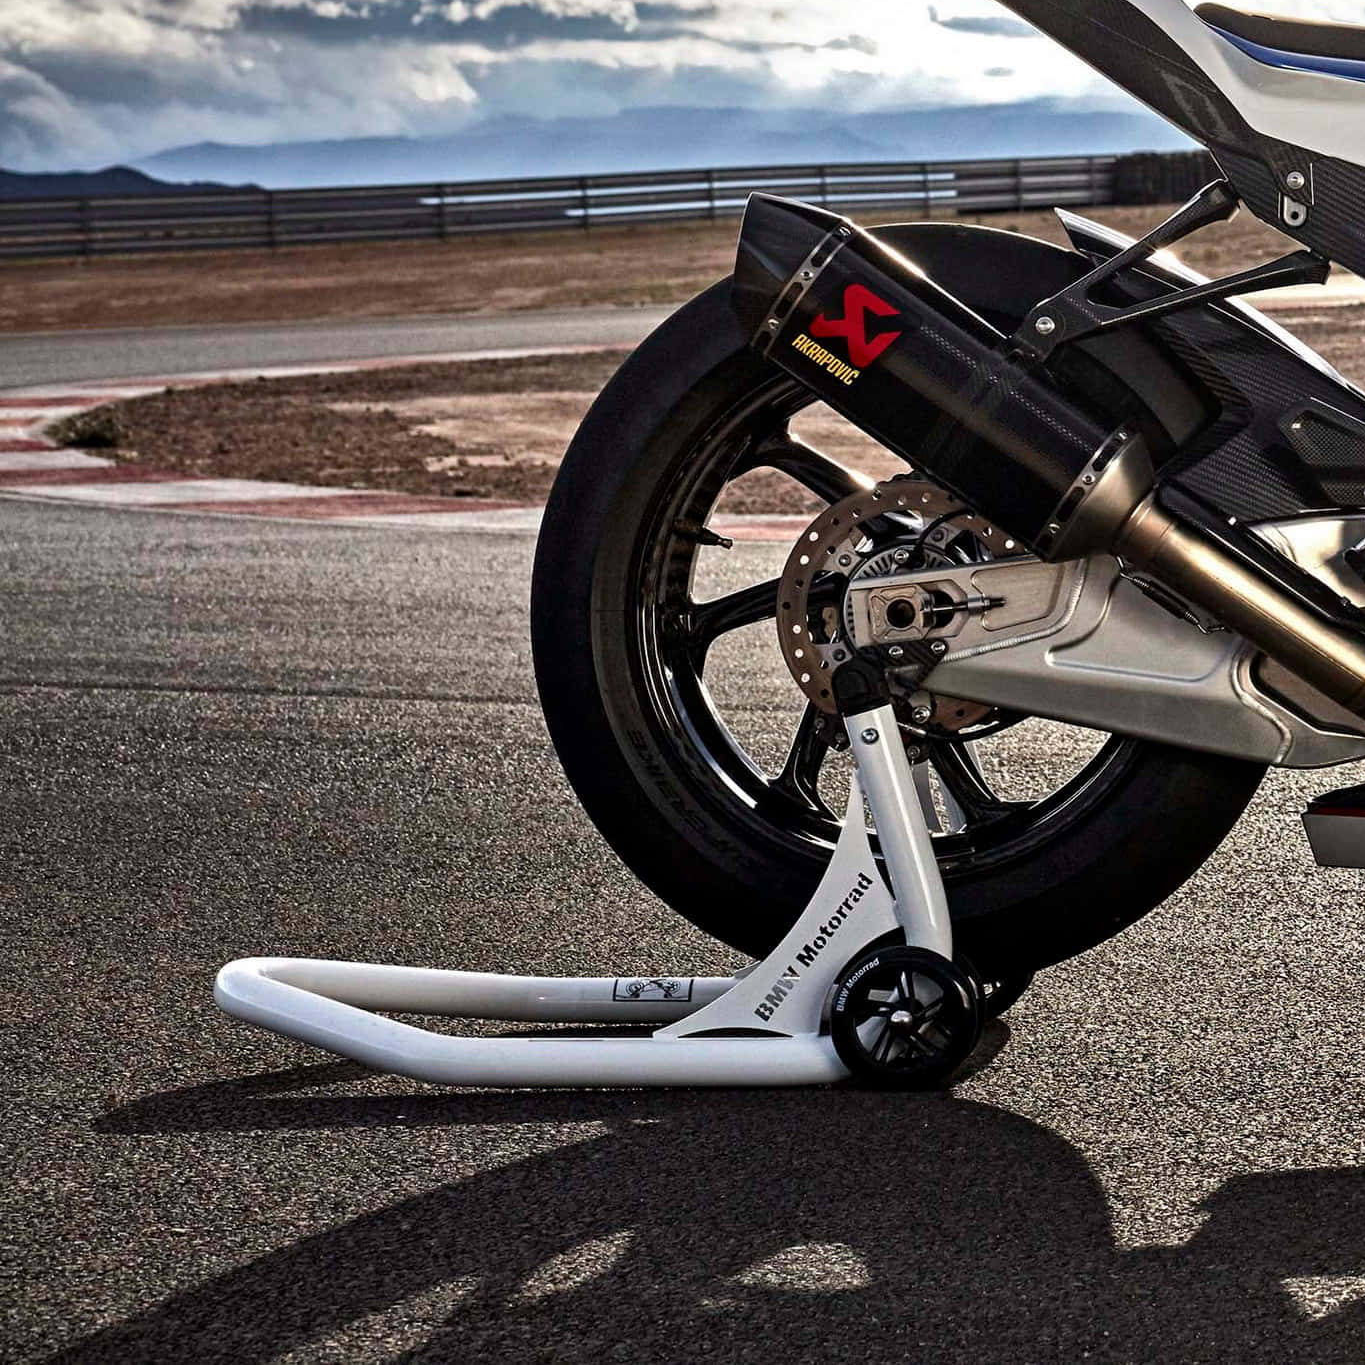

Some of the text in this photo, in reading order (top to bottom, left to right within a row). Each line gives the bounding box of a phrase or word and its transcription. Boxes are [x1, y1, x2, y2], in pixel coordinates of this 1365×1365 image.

[754, 872, 873, 1022] BMW Motorrad
[836, 957, 880, 1012] BMW Motorrad
